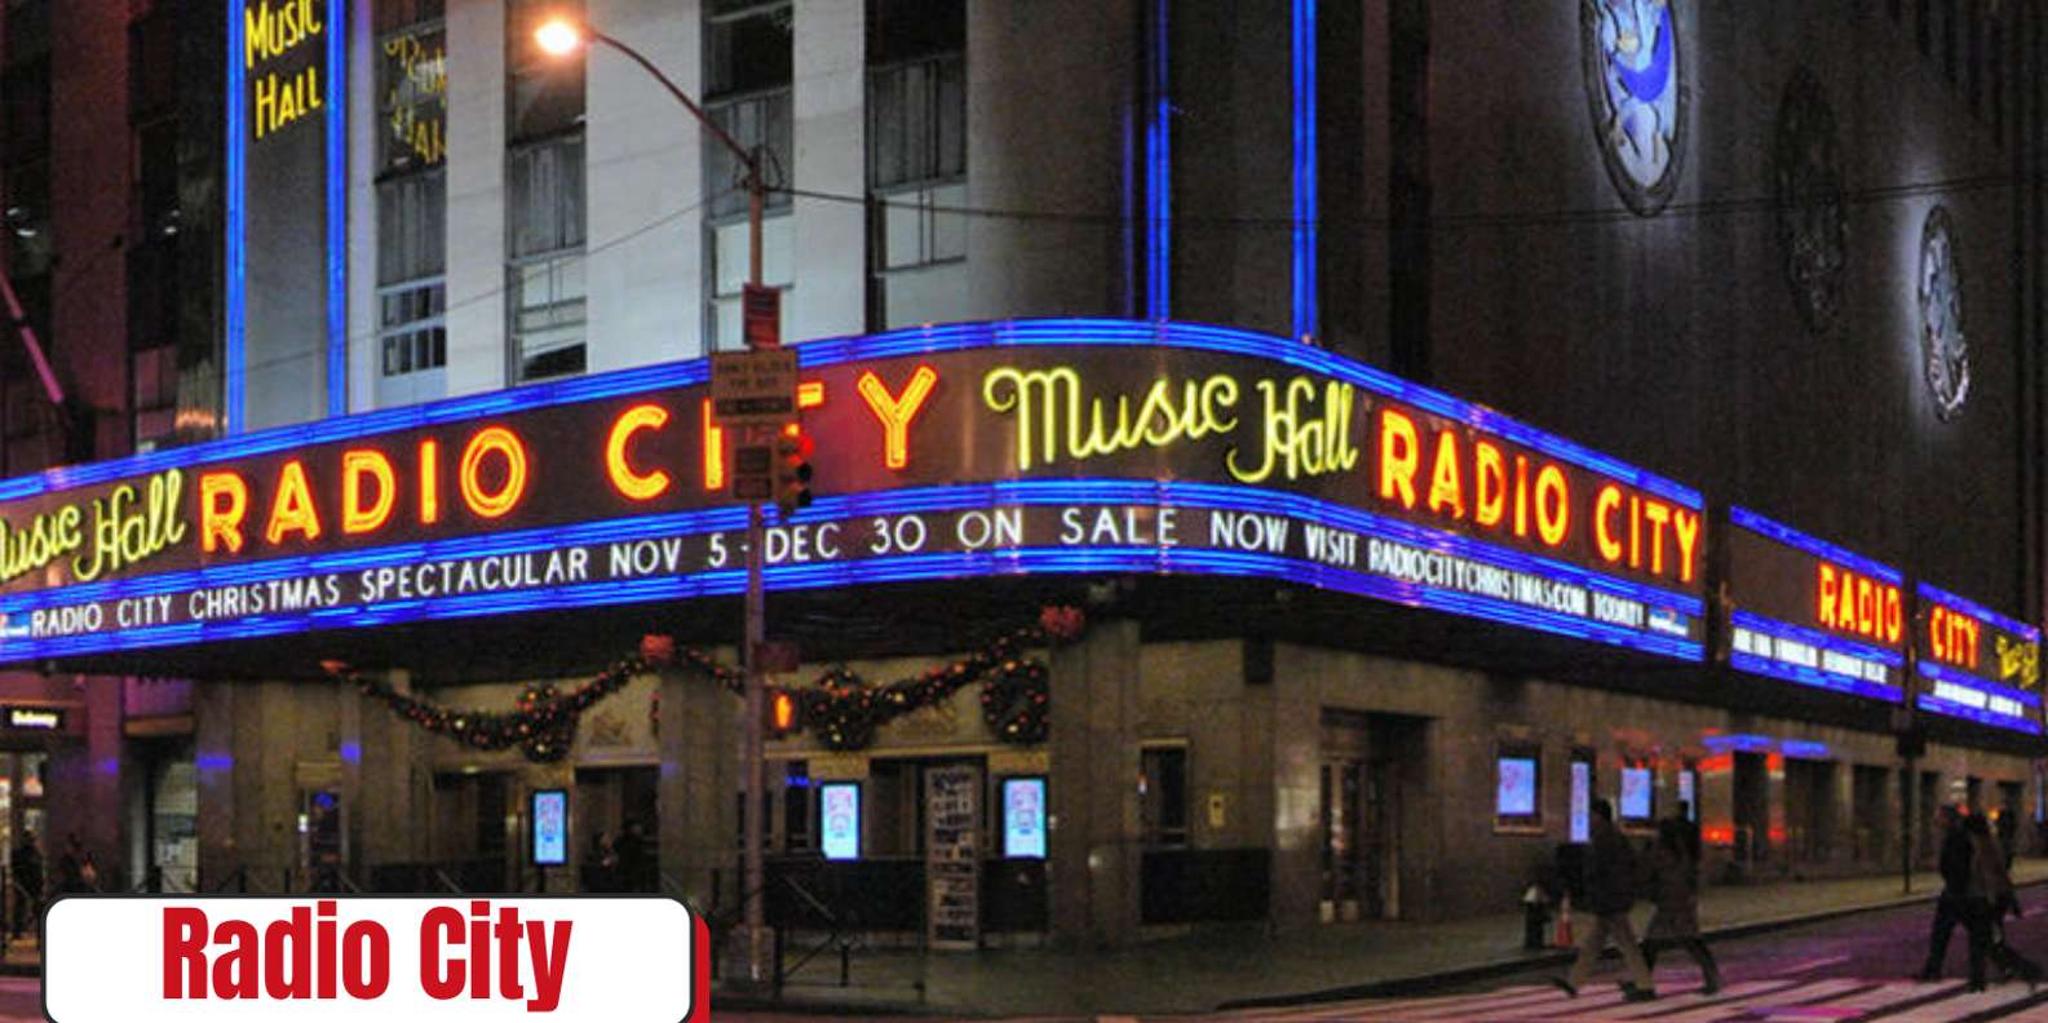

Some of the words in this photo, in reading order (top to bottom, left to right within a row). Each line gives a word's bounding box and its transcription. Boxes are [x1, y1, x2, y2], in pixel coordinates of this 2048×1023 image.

[200, 426, 527, 553] RADIO
[606, 366, 938, 500] CIY
[983, 367, 1239, 471] Music
[1226, 376, 1359, 484] Hall
[0, 505, 81, 579] usic
[72, 467, 187, 581] Hall
[1380, 408, 1569, 547] RADIO
[1594, 484, 1699, 582] CITY
[31, 603, 103, 639] RADIO
[116, 594, 173, 629] CITY
[188, 573, 340, 621] CHRISTMAS
[360, 547, 590, 603] SPECTACULAR
[609, 537, 682, 577] NOV
[707, 532, 728, 568] 5
[763, 521, 841, 564] DEC
[870, 513, 927, 554] 30
[956, 508, 1024, 548] ON
[1059, 507, 1179, 546] SALE
[1210, 509, 1289, 553] NOW
[1304, 523, 1358, 567] VISIT
[1817, 562, 1904, 644] RADIO
[1929, 604, 1981, 670] CITY
